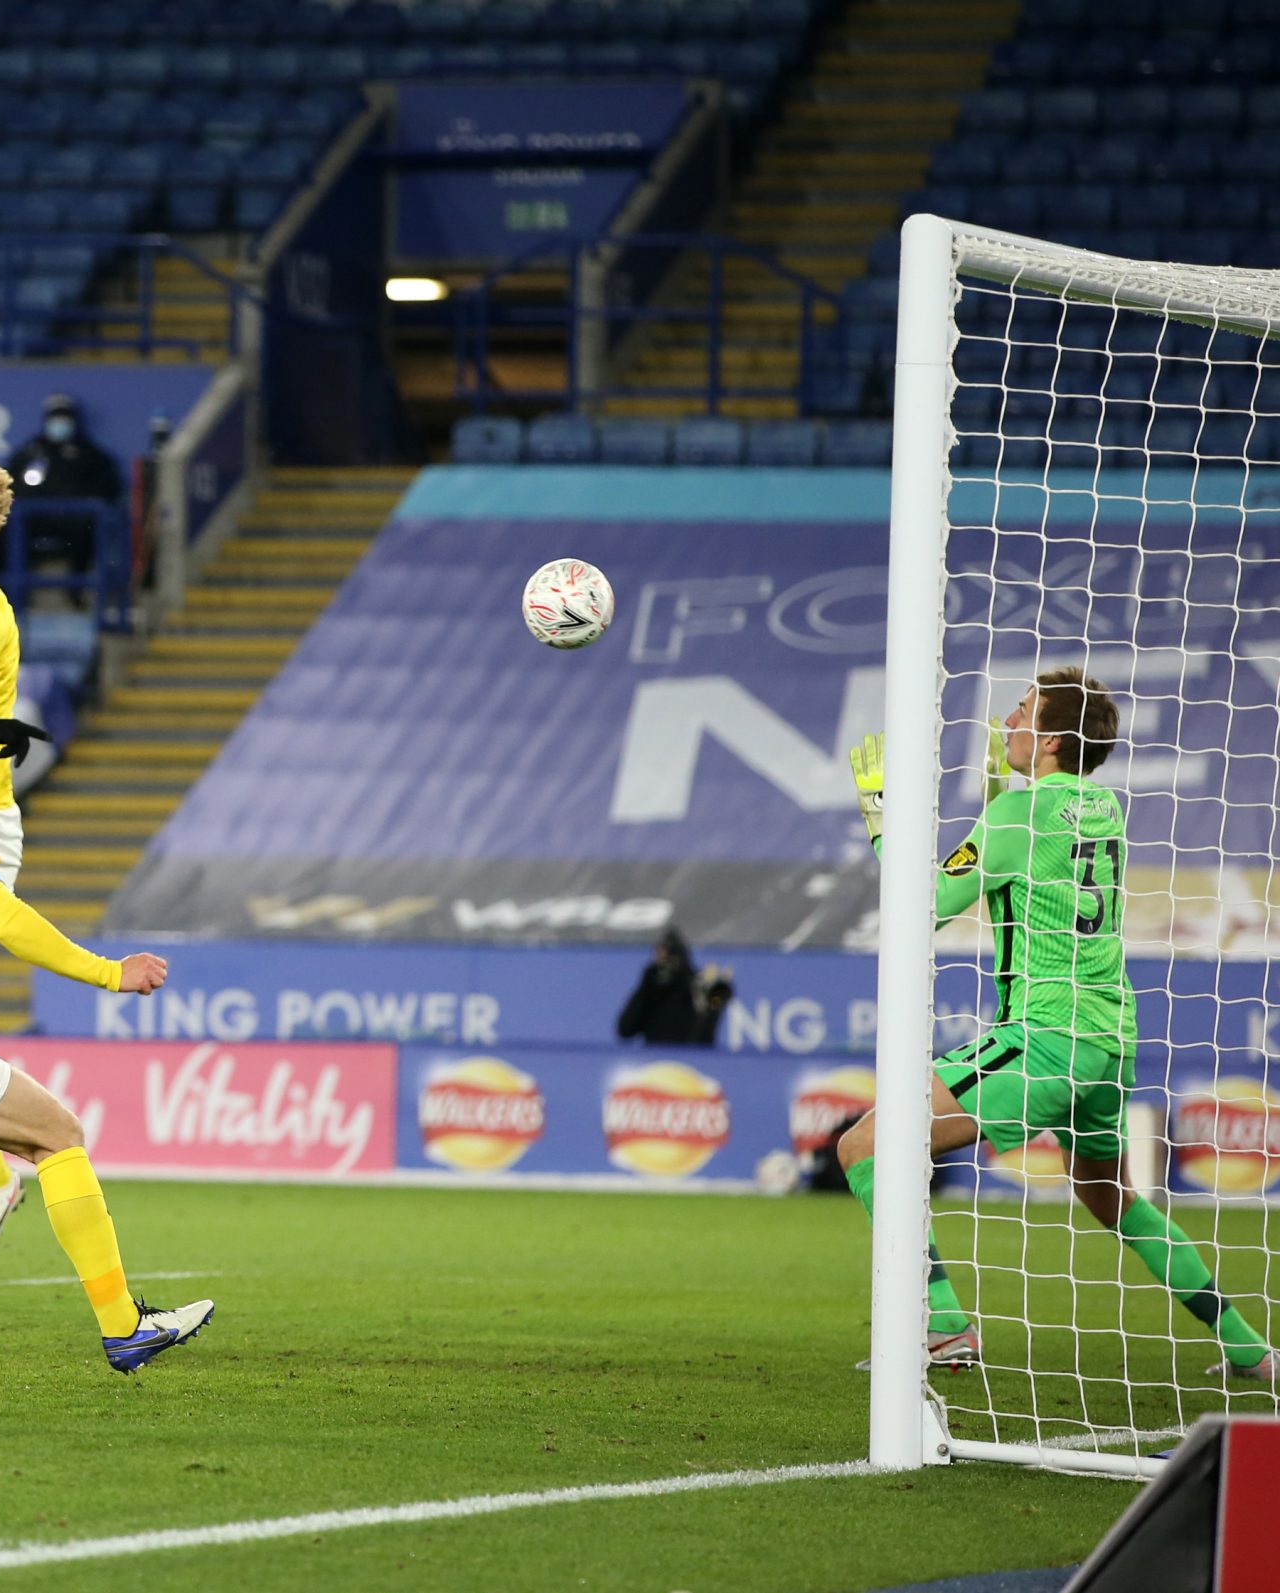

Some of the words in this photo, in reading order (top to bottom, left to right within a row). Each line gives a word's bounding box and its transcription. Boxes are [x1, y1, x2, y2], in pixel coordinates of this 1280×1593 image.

[1070, 839, 1120, 935] 31
[95, 988, 260, 1043] KING
[276, 989, 502, 1048] POWER
[725, 997, 826, 1054] NG
[143, 1041, 376, 1174] Vitality
[419, 1087, 546, 1133] WALKERS
[604, 1095, 730, 1139] WALKERS
